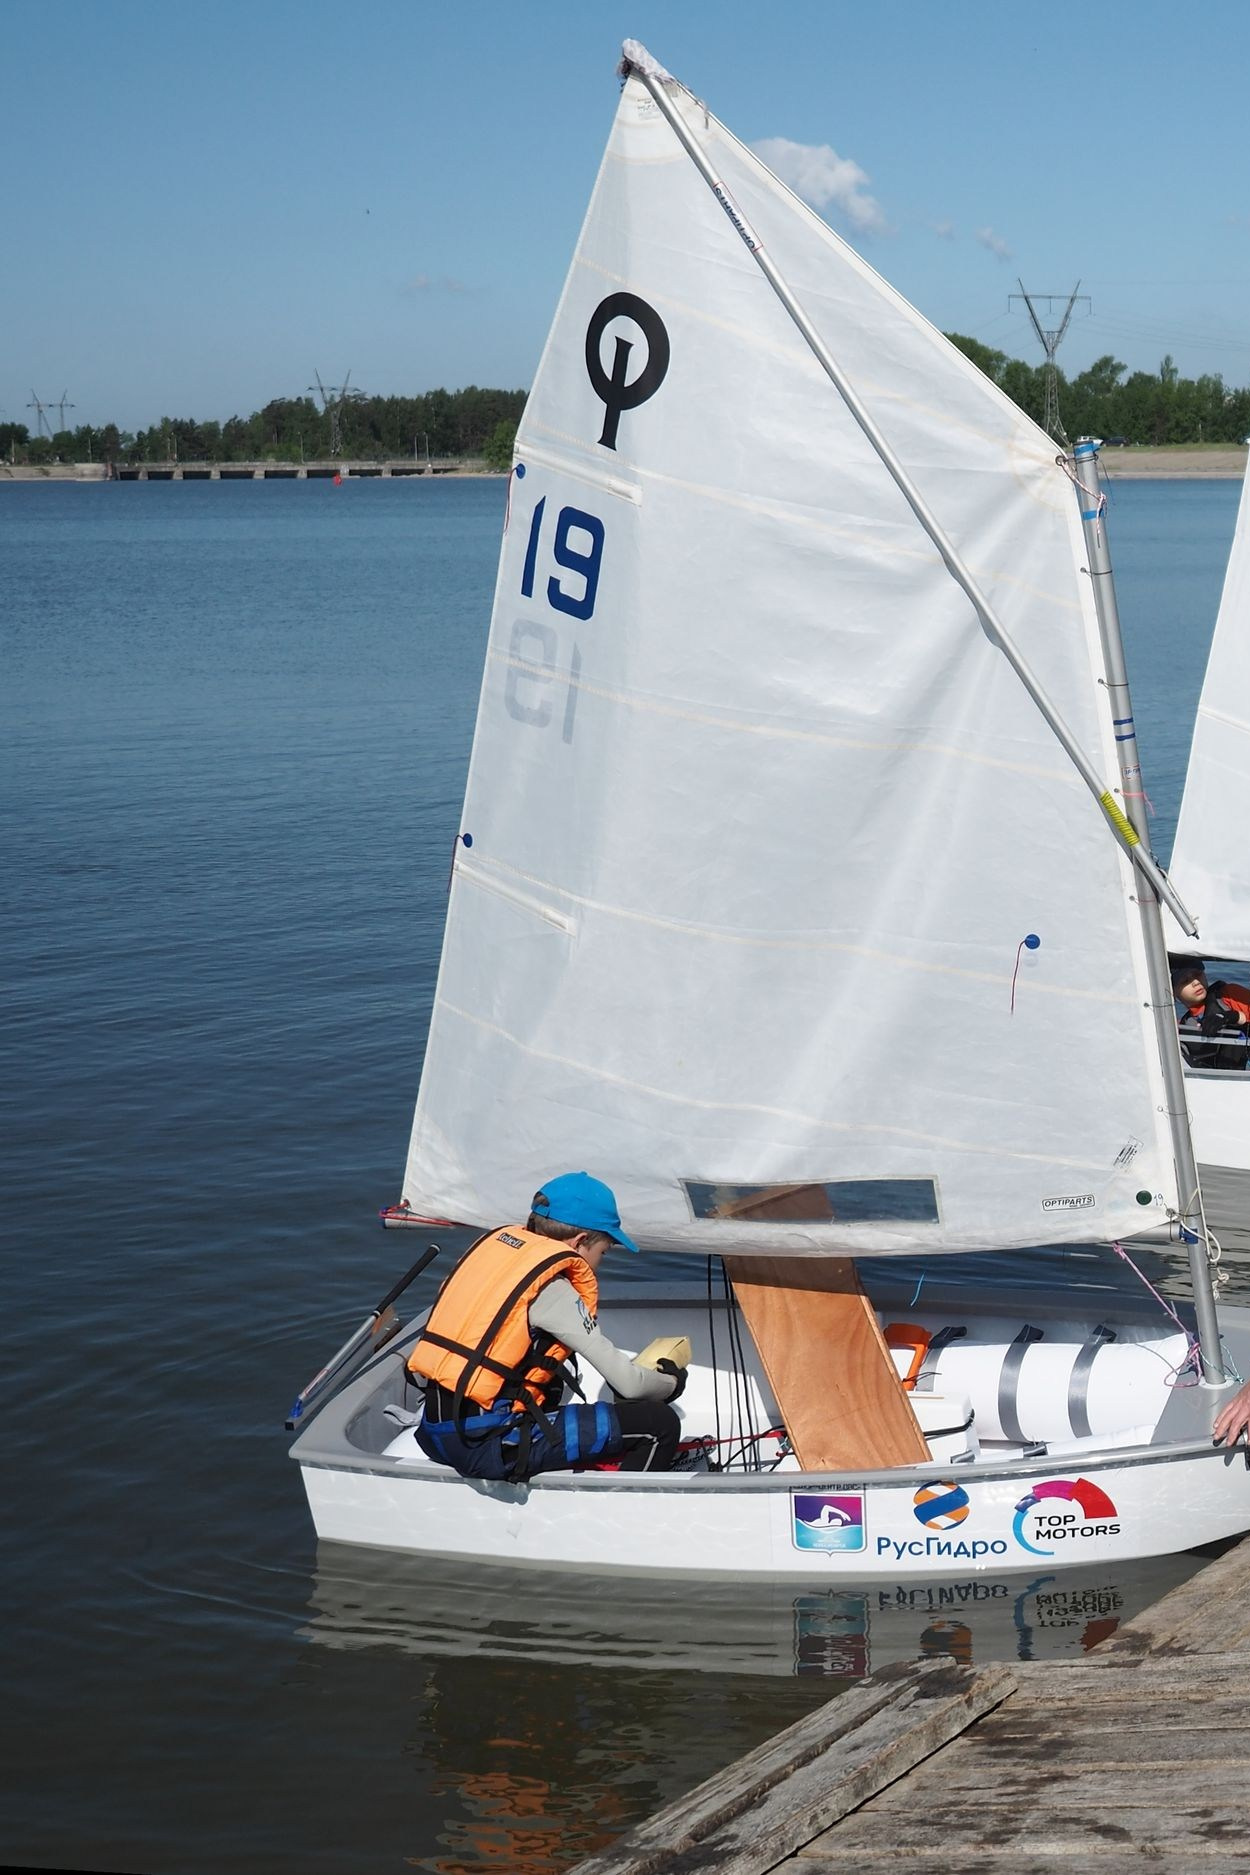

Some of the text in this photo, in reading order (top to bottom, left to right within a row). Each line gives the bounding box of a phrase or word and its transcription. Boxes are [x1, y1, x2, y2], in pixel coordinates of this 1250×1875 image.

[520, 495, 605, 621] 19
[1044, 1196, 1092, 1207] OPTIPARTS
[1034, 1514, 1076, 1527] TOP
[1036, 1524, 1121, 1540] MOTORS
[876, 1536, 1008, 1560] РусГидро
